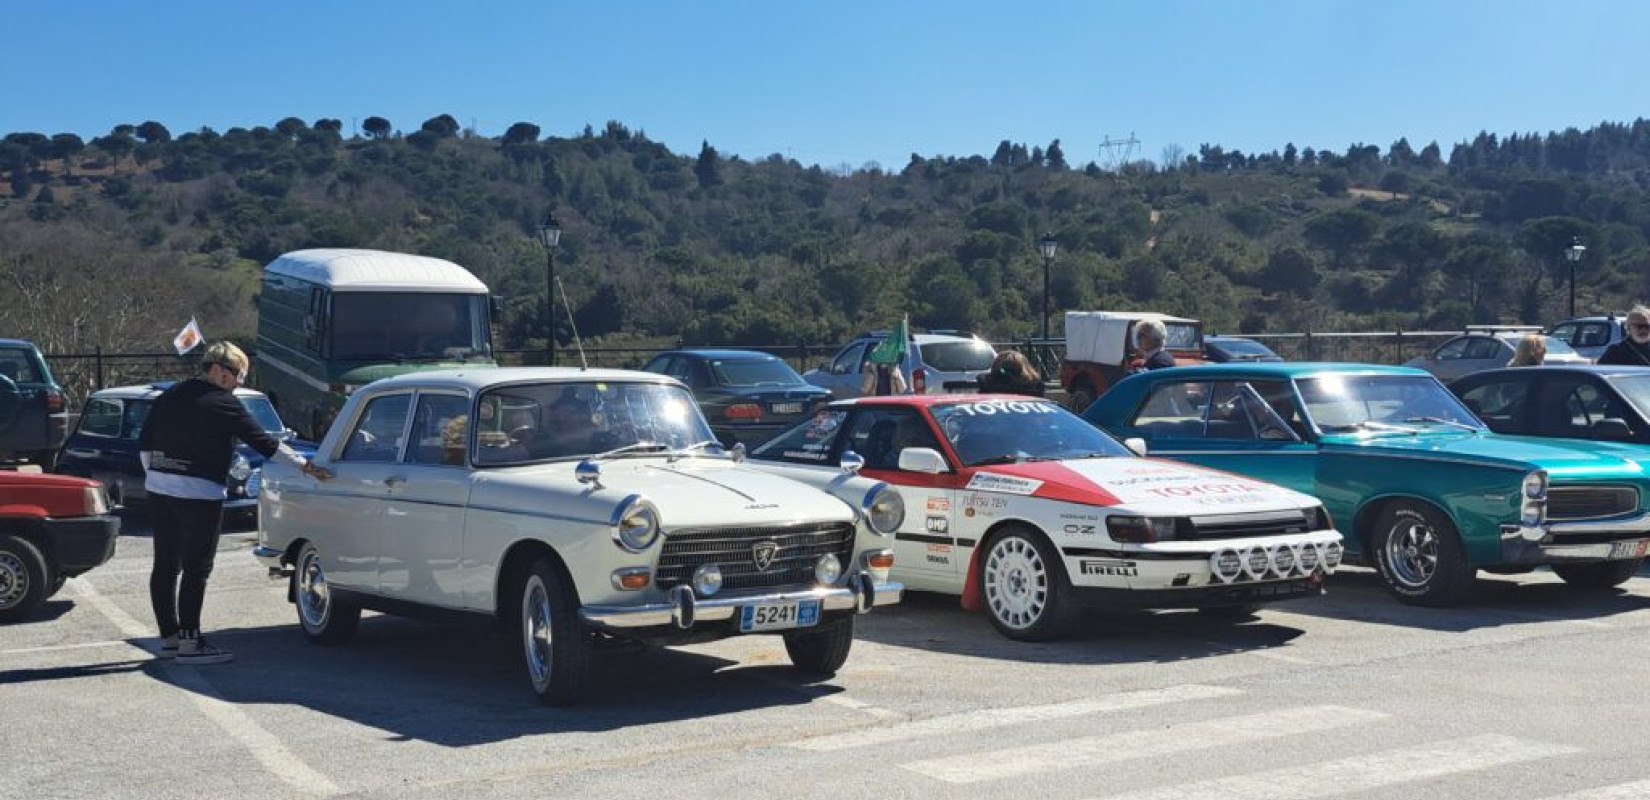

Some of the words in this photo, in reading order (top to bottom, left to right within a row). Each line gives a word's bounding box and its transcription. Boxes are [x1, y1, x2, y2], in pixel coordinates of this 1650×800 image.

[955, 400, 1058, 416] TOYOTA
[1146, 483, 1257, 499] TOYOTA
[1080, 560, 1139, 577] PIRELLI
[755, 604, 797, 624] 5241
